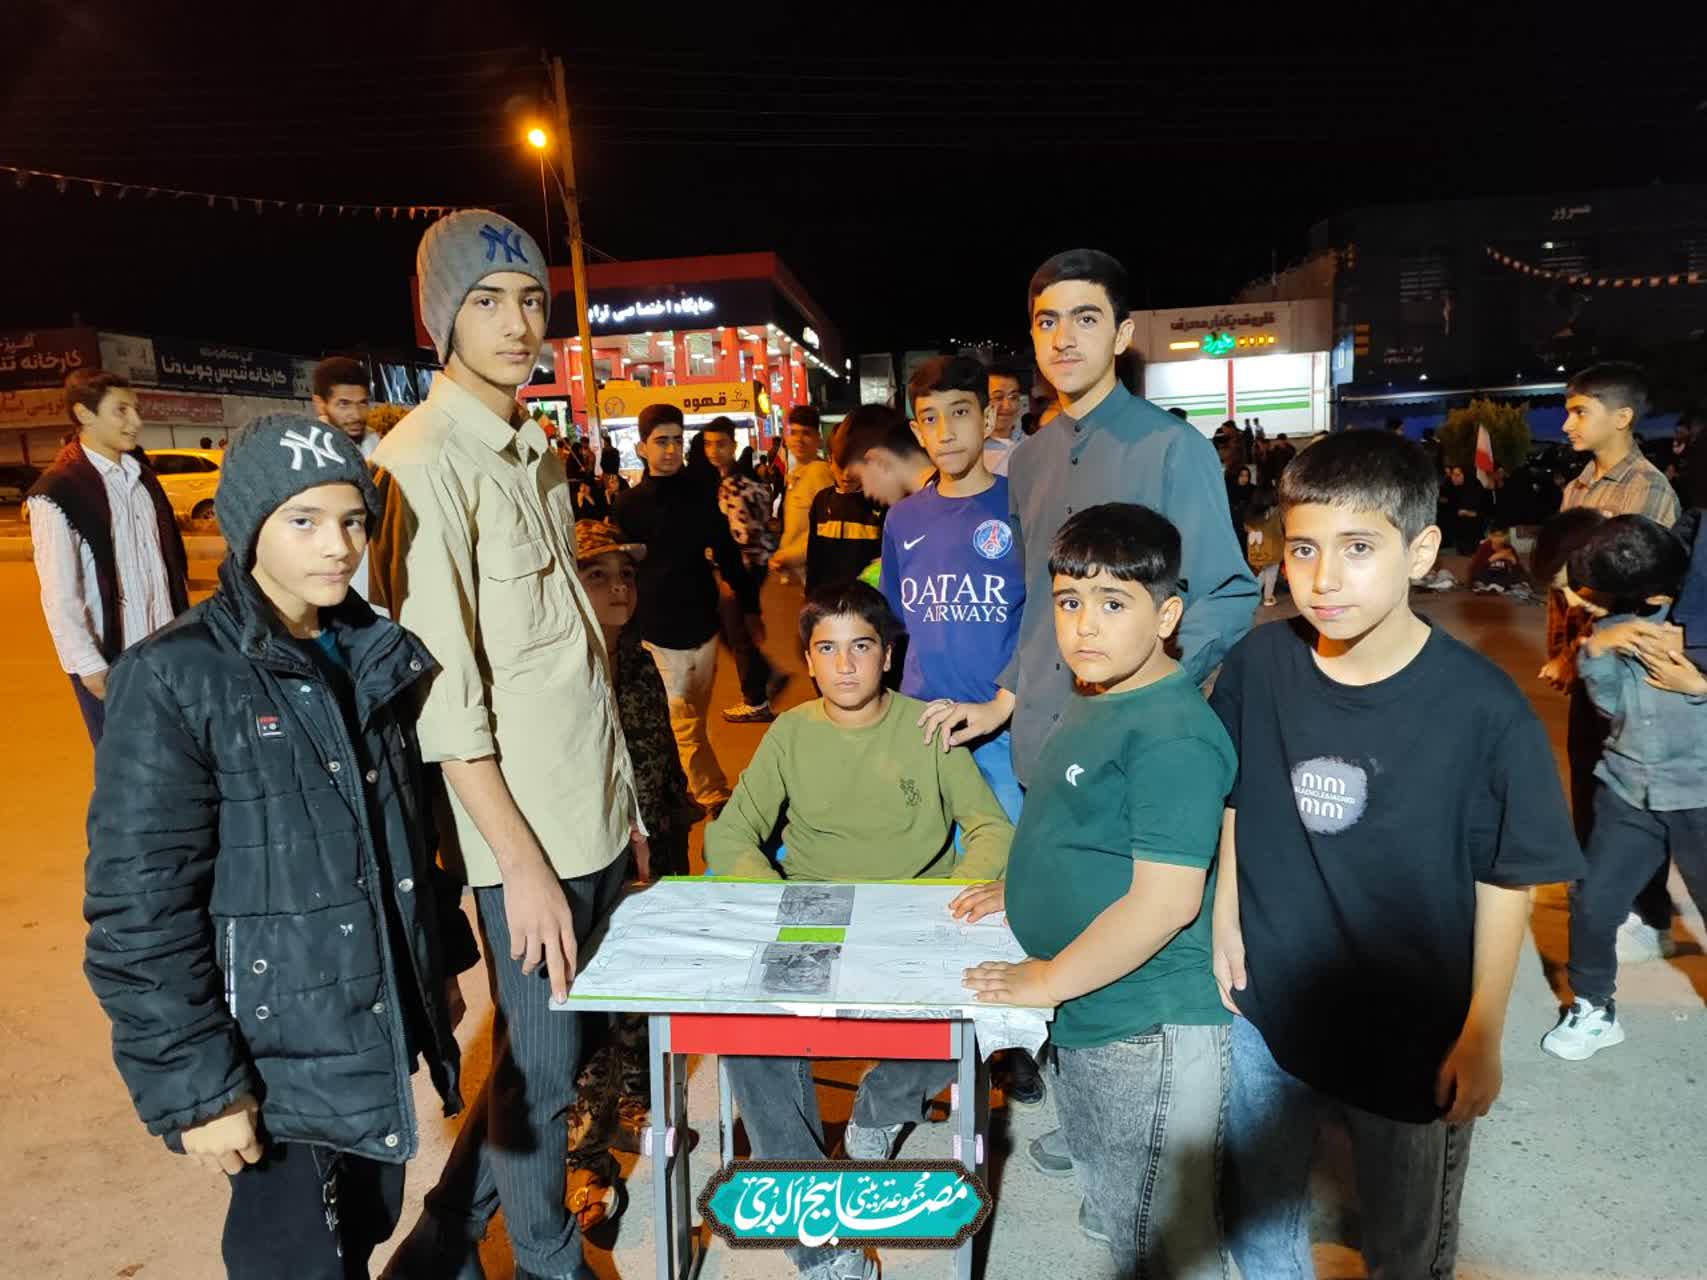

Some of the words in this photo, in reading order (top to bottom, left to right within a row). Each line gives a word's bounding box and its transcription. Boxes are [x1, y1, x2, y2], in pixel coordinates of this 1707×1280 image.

[613, 300, 672, 321] اختصاصی
[20, 348, 81, 373] کارخانه
[683, 391, 727, 412] قهوه
[901, 573, 1009, 612] QATAR
[922, 604, 1009, 623] AIRWAYS
